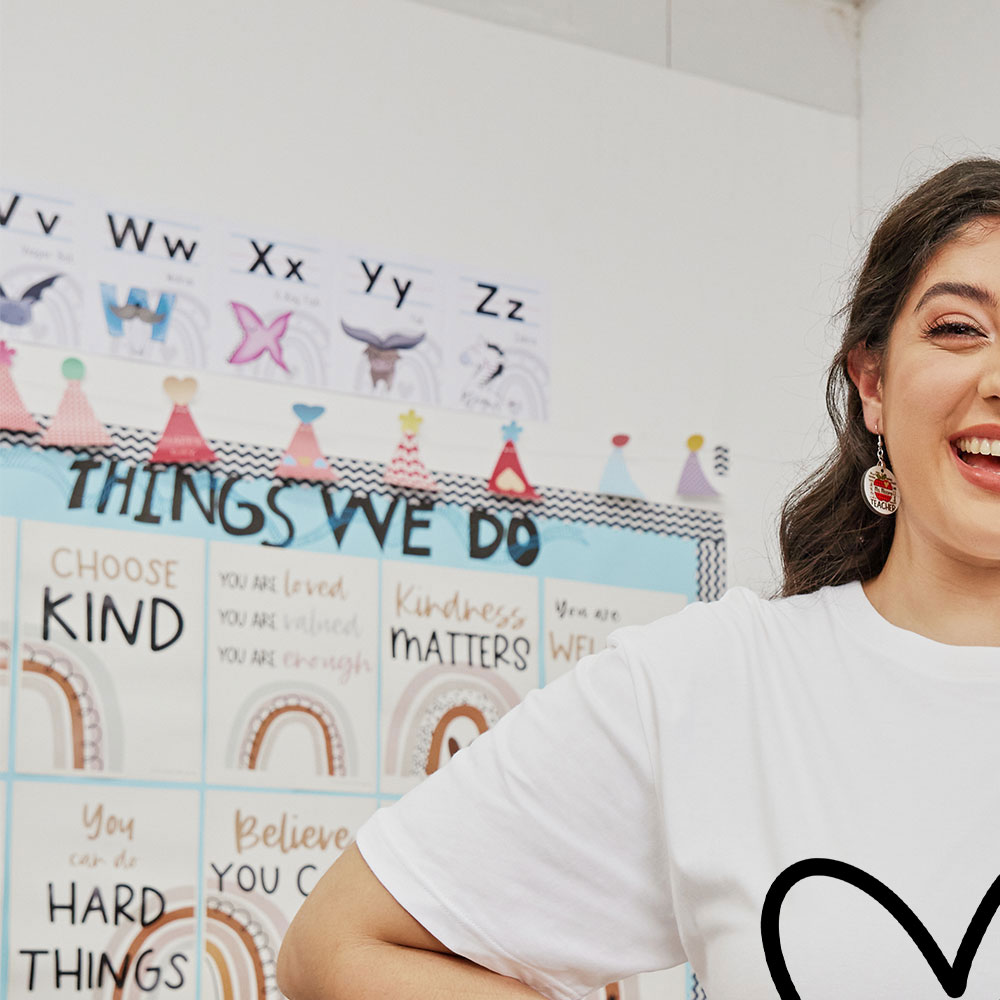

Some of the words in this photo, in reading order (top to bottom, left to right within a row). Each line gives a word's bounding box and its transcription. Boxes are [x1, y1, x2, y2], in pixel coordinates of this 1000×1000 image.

[67, 458, 296, 548] THINGS
[320, 490, 433, 557] WE
[468, 507, 541, 567] DO
[51, 547, 179, 589] CHOOSE
[219, 570, 247, 591] YOU
[252, 572, 277, 593] ARE
[284, 568, 348, 600] loved
[42, 586, 185, 652] KIND
[219, 608, 247, 629] YOU
[252, 610, 277, 630] ARE
[284, 607, 364, 638] valued
[394, 580, 528, 631] Kindness
[219, 647, 247, 667] YOU
[252, 648, 276, 668] ARE
[284, 650, 374, 684] enough
[82, 802, 135, 841] You
[233, 807, 352, 855] Believe
[69, 852, 105, 869] can
[113, 849, 139, 870] do
[210, 861, 279, 895] YOU
[48, 881, 166, 928] HARD
[19, 946, 189, 993] THINGS
